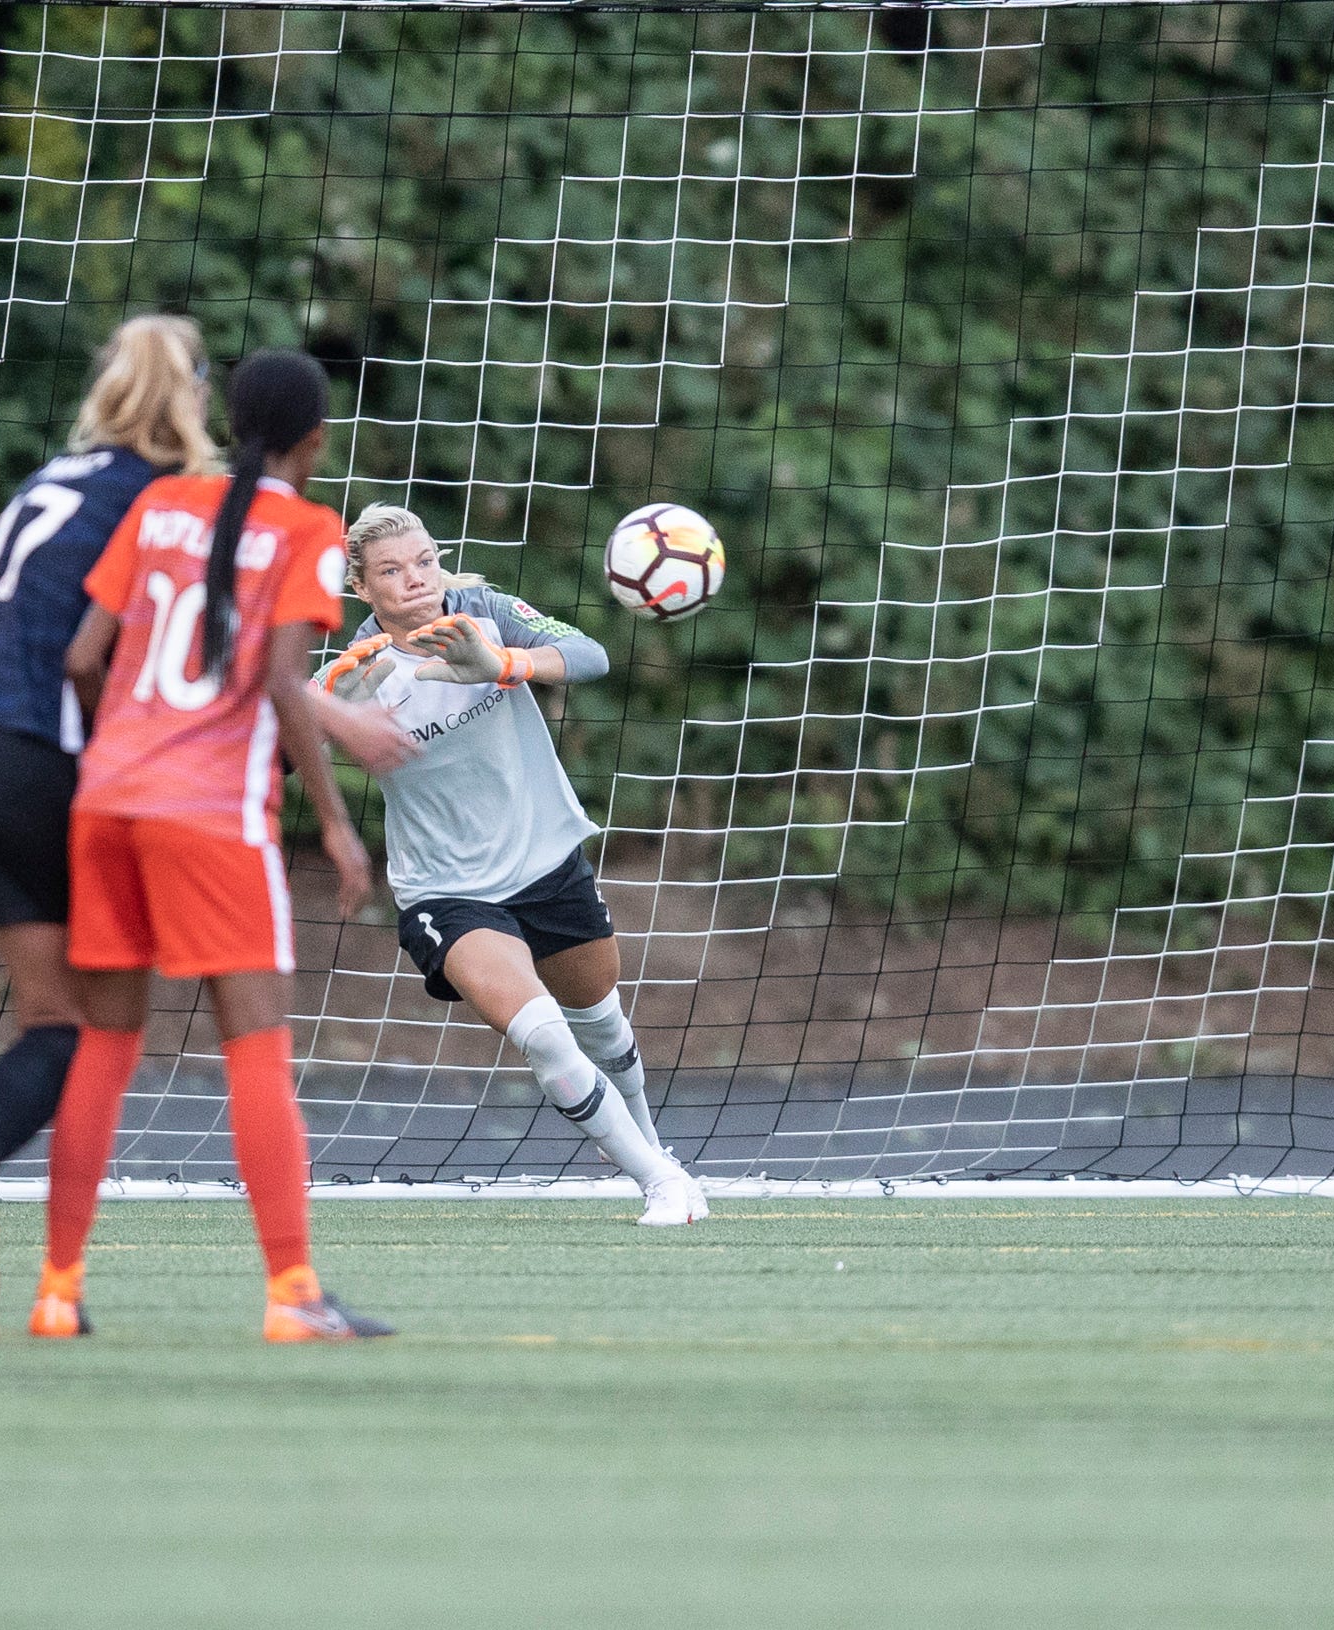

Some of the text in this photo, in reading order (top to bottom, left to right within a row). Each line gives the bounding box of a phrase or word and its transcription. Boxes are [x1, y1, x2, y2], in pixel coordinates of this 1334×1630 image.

[133, 570, 243, 711] 10
[404, 687, 507, 746] BVA Compa
